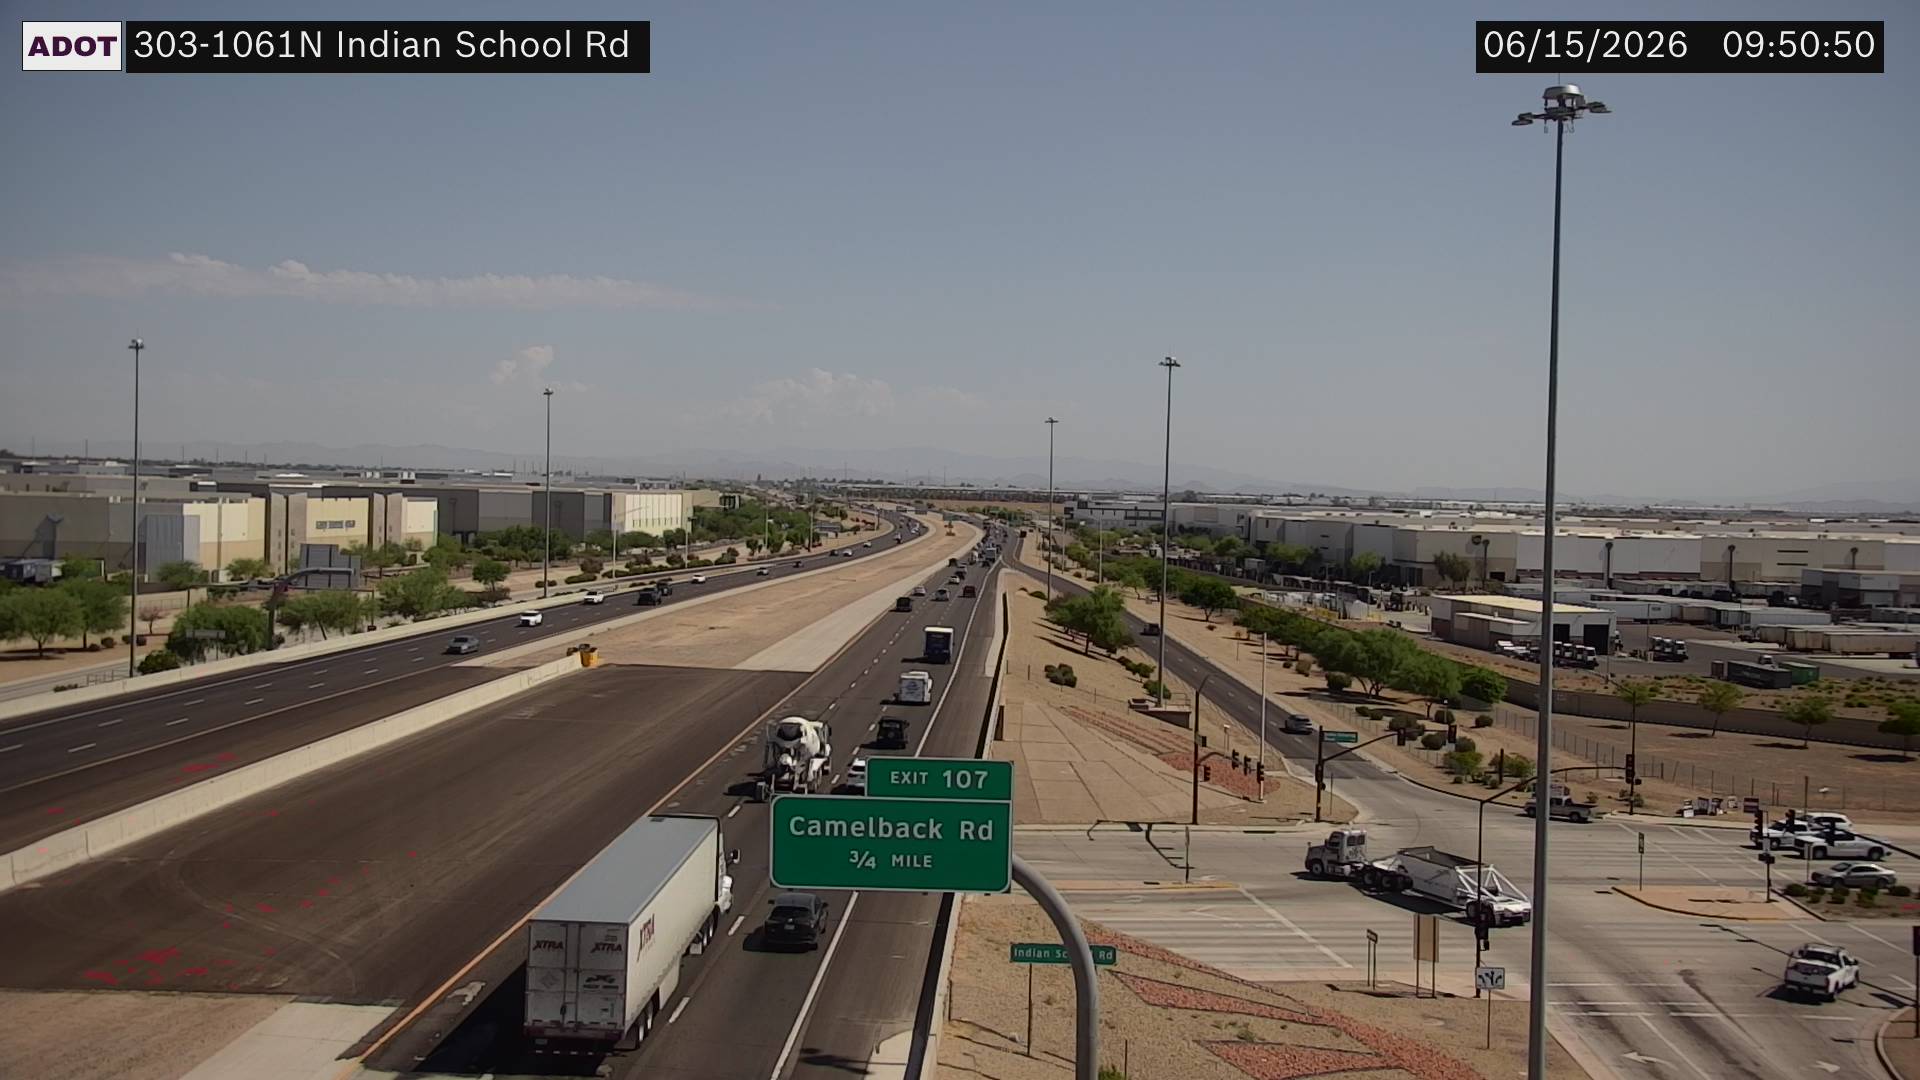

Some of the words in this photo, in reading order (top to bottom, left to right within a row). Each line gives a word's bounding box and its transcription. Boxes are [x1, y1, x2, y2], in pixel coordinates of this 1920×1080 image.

[890, 771, 929, 785] EXIT
[943, 770, 988, 789] 107
[789, 816, 943, 839] Camelback
[960, 820, 993, 841] Rd
[891, 854, 932, 868] MILE
[533, 940, 564, 951] XTRA
[590, 942, 622, 953] XTRA
[1014, 948, 1050, 958] Indian
[1098, 950, 1113, 960] Rd
